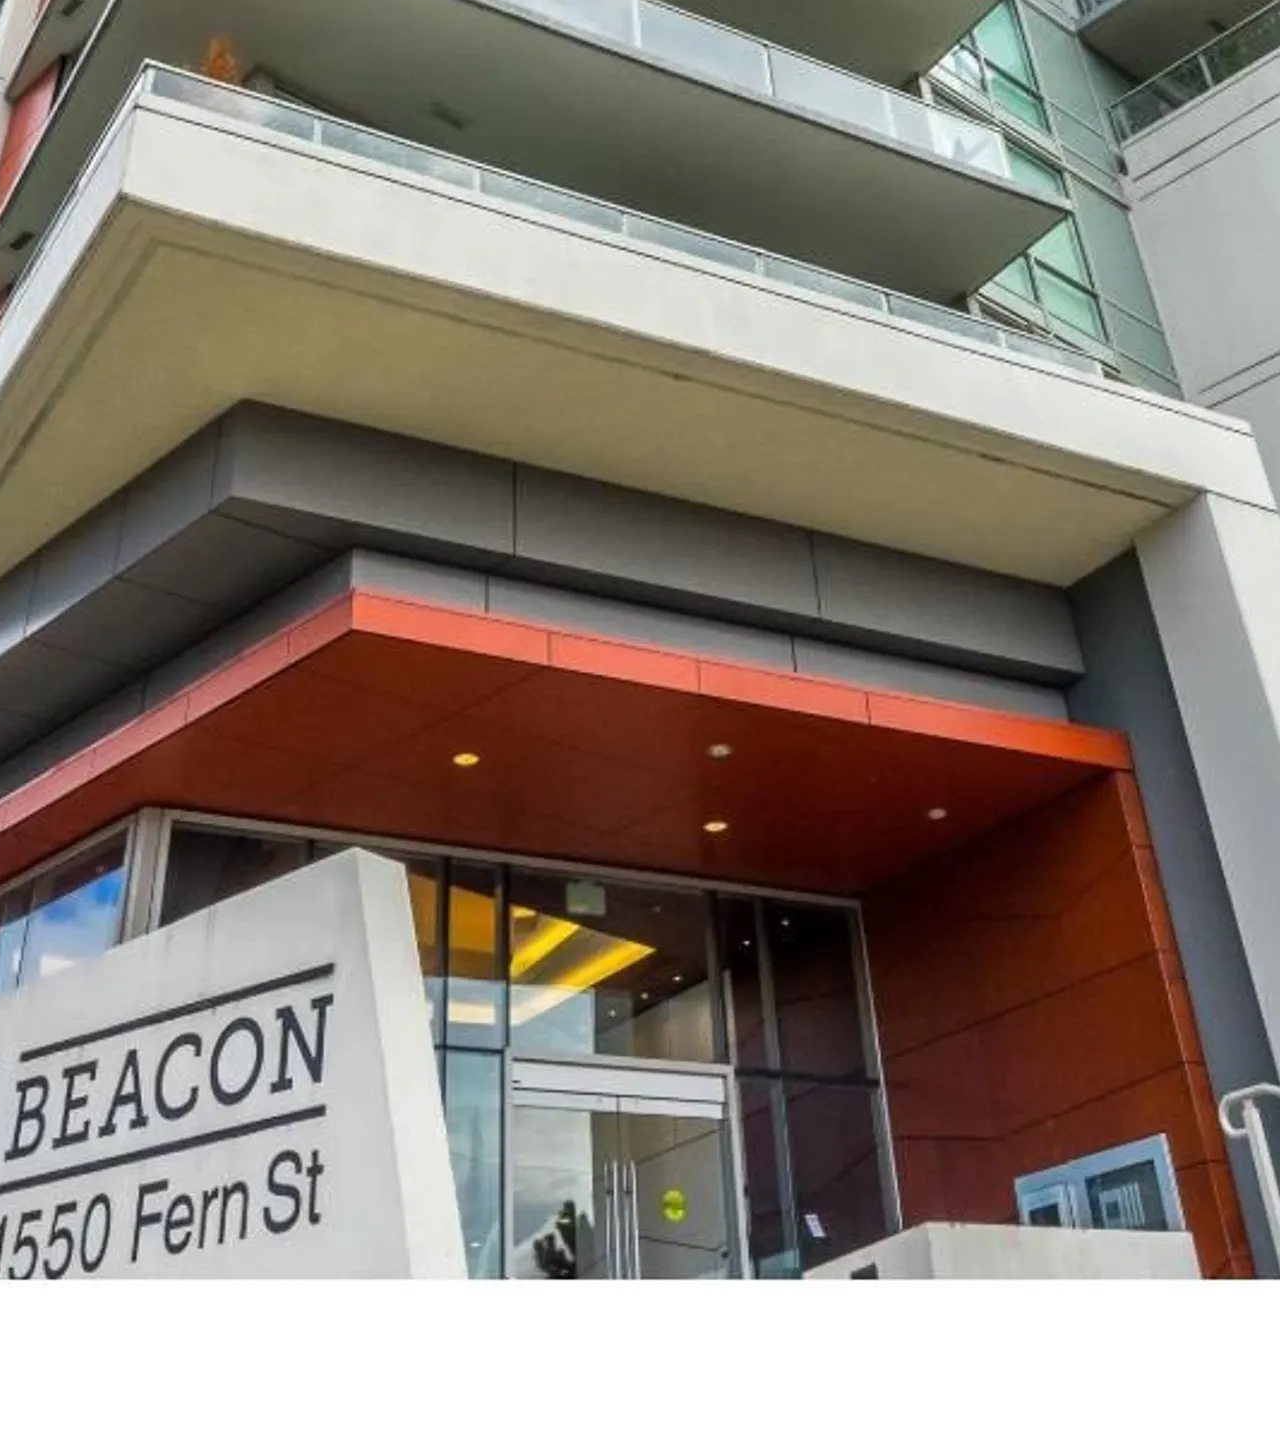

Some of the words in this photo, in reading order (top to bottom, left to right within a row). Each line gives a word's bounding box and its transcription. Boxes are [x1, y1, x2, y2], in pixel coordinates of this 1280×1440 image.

[4, 994, 335, 1163] BEACON
[130, 1179, 250, 1264] Fern
[263, 1149, 325, 1234] St
